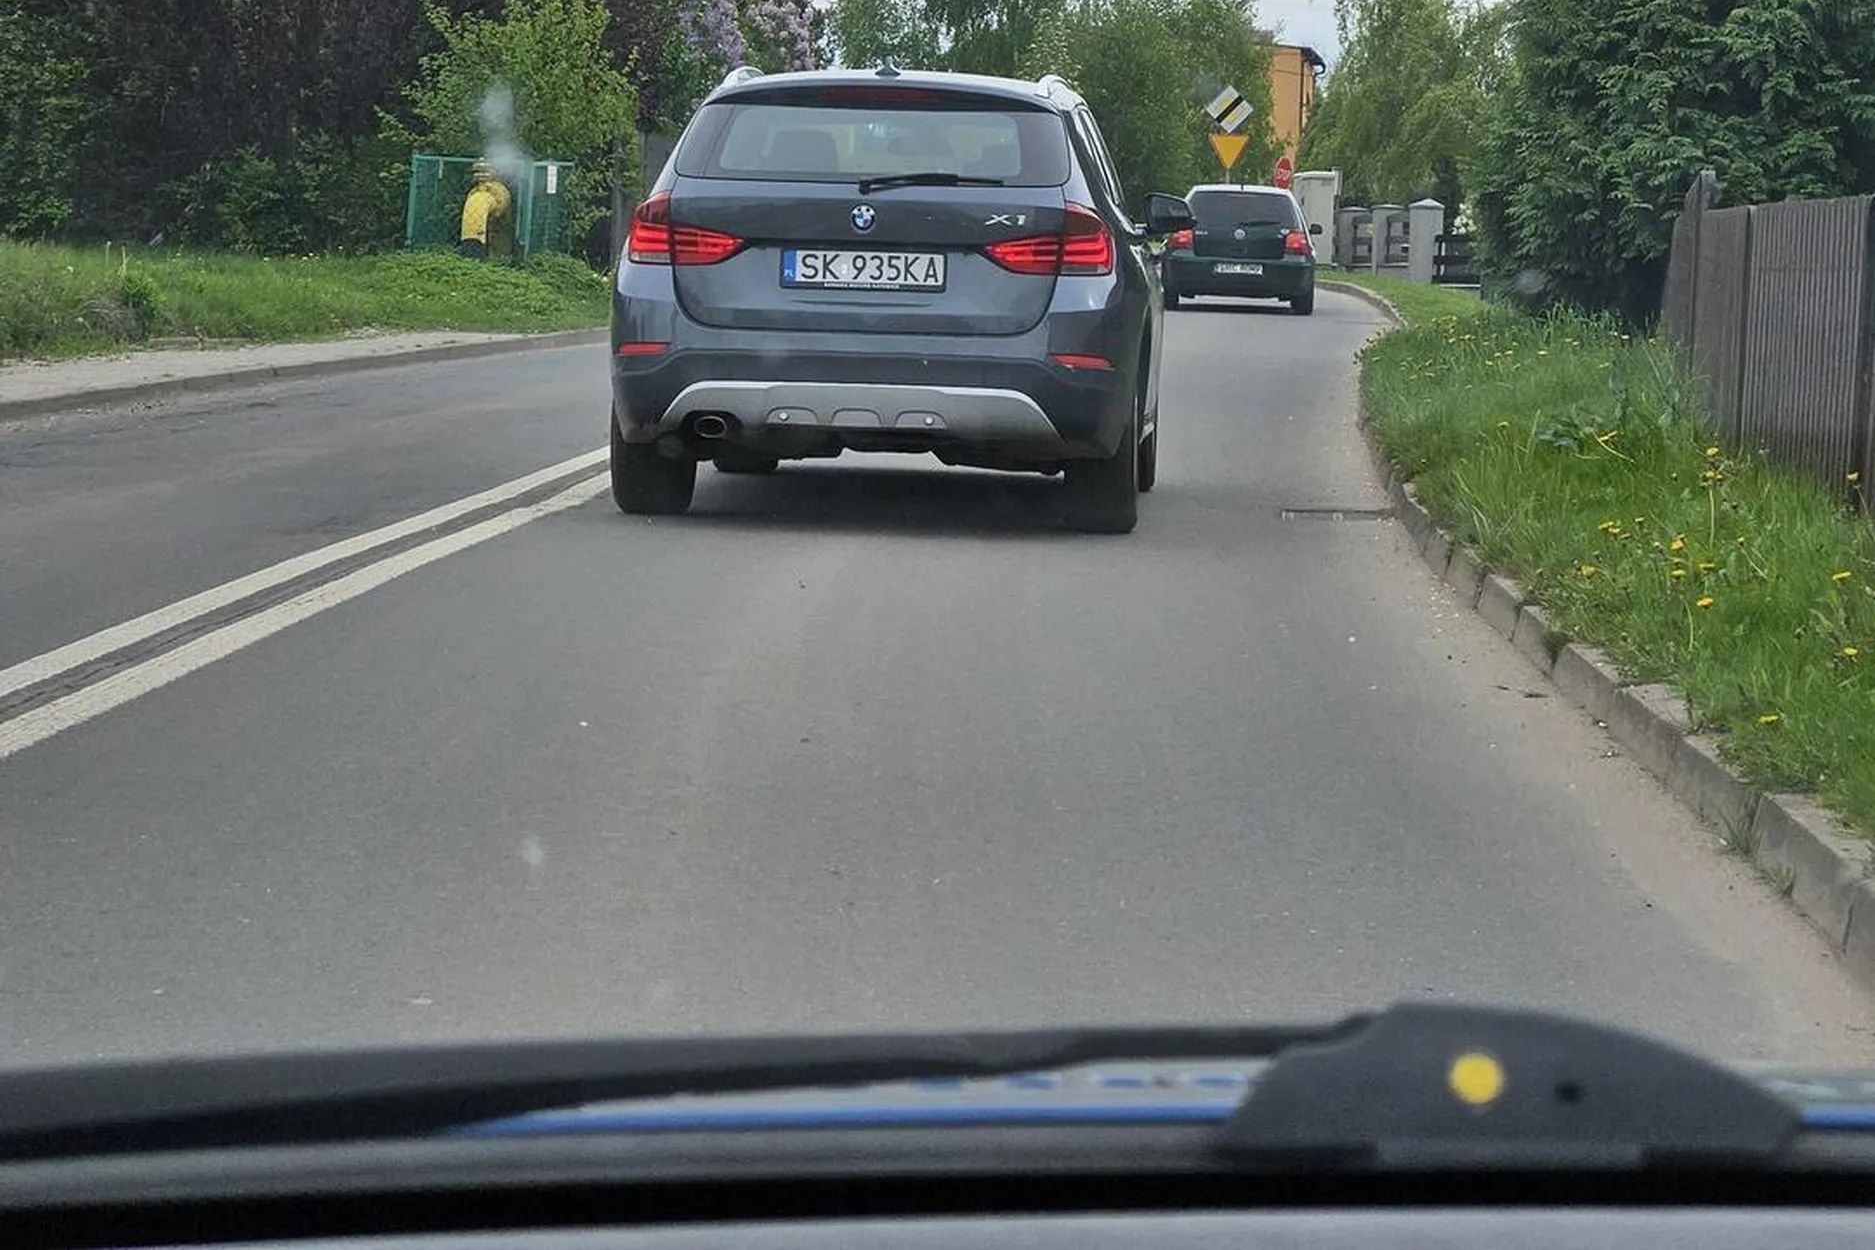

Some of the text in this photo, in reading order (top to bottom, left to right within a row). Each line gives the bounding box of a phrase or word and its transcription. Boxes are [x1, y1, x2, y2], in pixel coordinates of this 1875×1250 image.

[985, 214, 1026, 225] X1
[800, 253, 941, 283] SK 935KA
